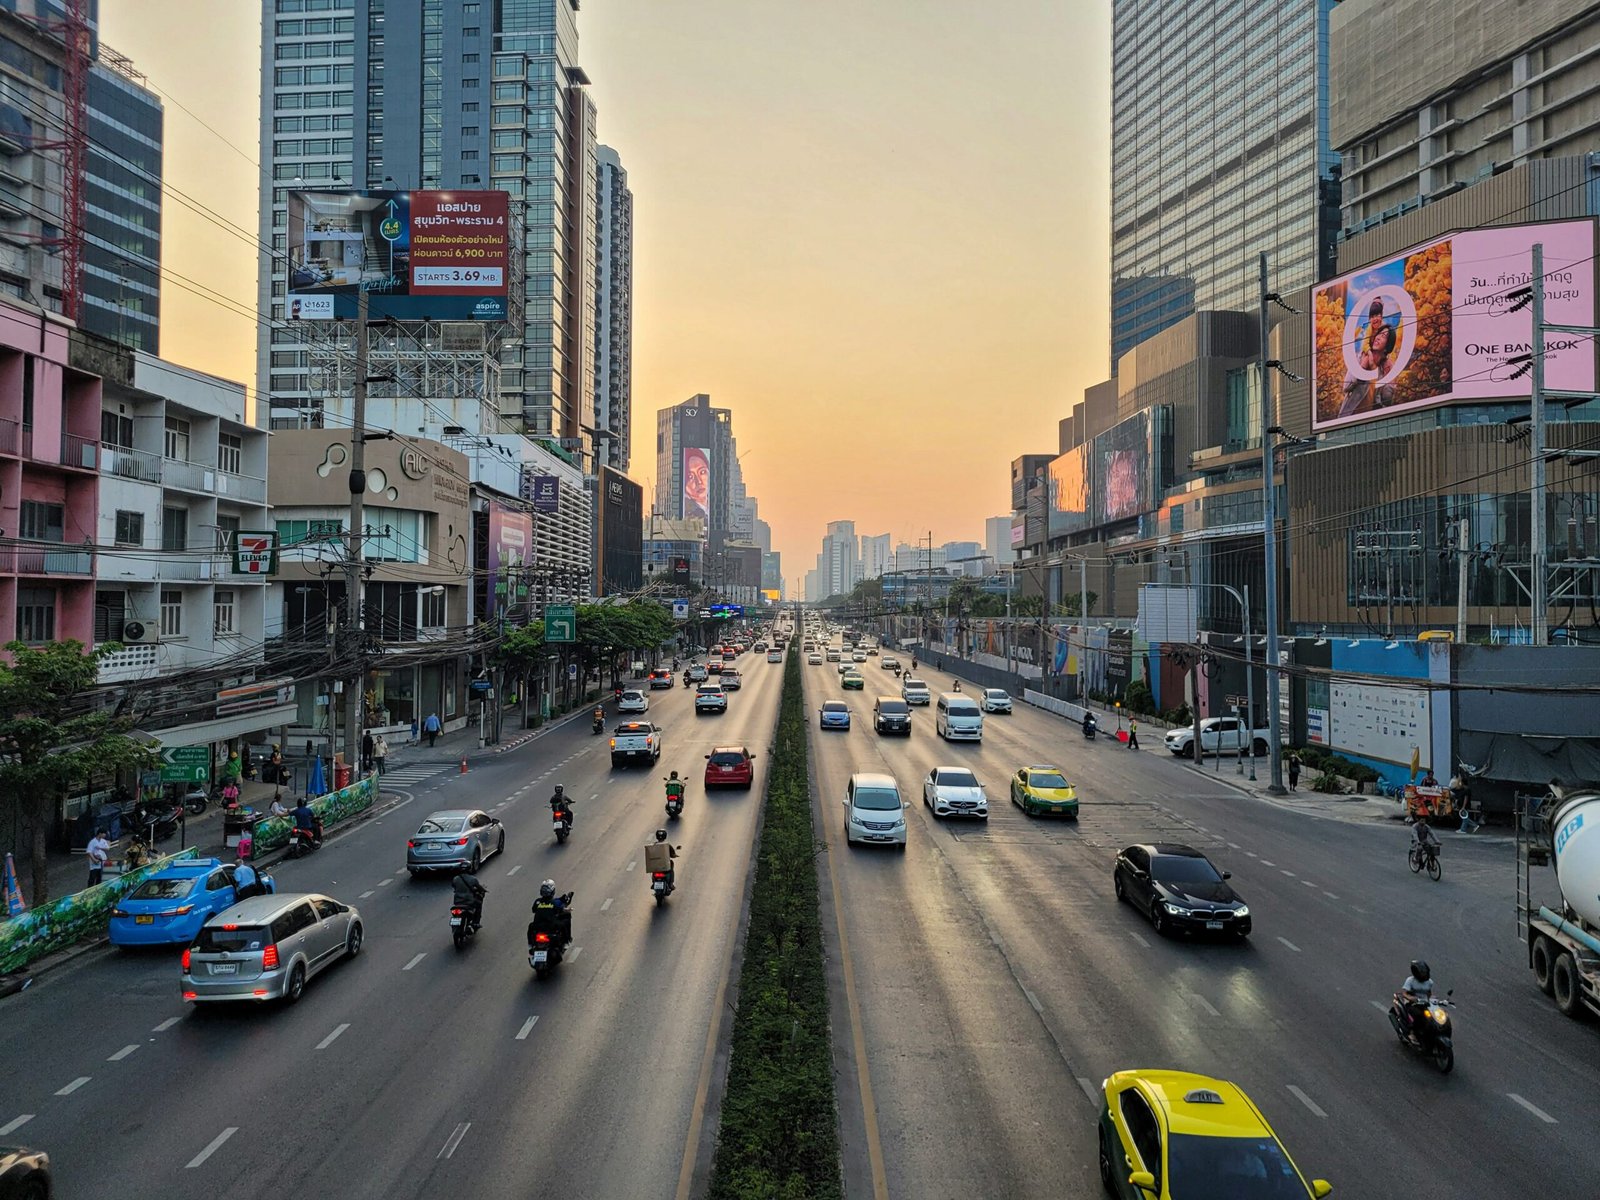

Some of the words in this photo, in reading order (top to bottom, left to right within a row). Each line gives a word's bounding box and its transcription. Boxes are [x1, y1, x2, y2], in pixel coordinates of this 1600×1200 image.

[437, 202, 481, 212] แอสปาย
[496, 216, 504, 225] 4
[455, 249, 485, 259] 6,900
[487, 250, 503, 258] บาท
[452, 271, 480, 281] 3.69
[475, 302, 500, 310] aspire
[1465, 343, 1500, 356] ONE
[1504, 340, 1579, 353] BANKOK
[405, 452, 429, 474] AIC
